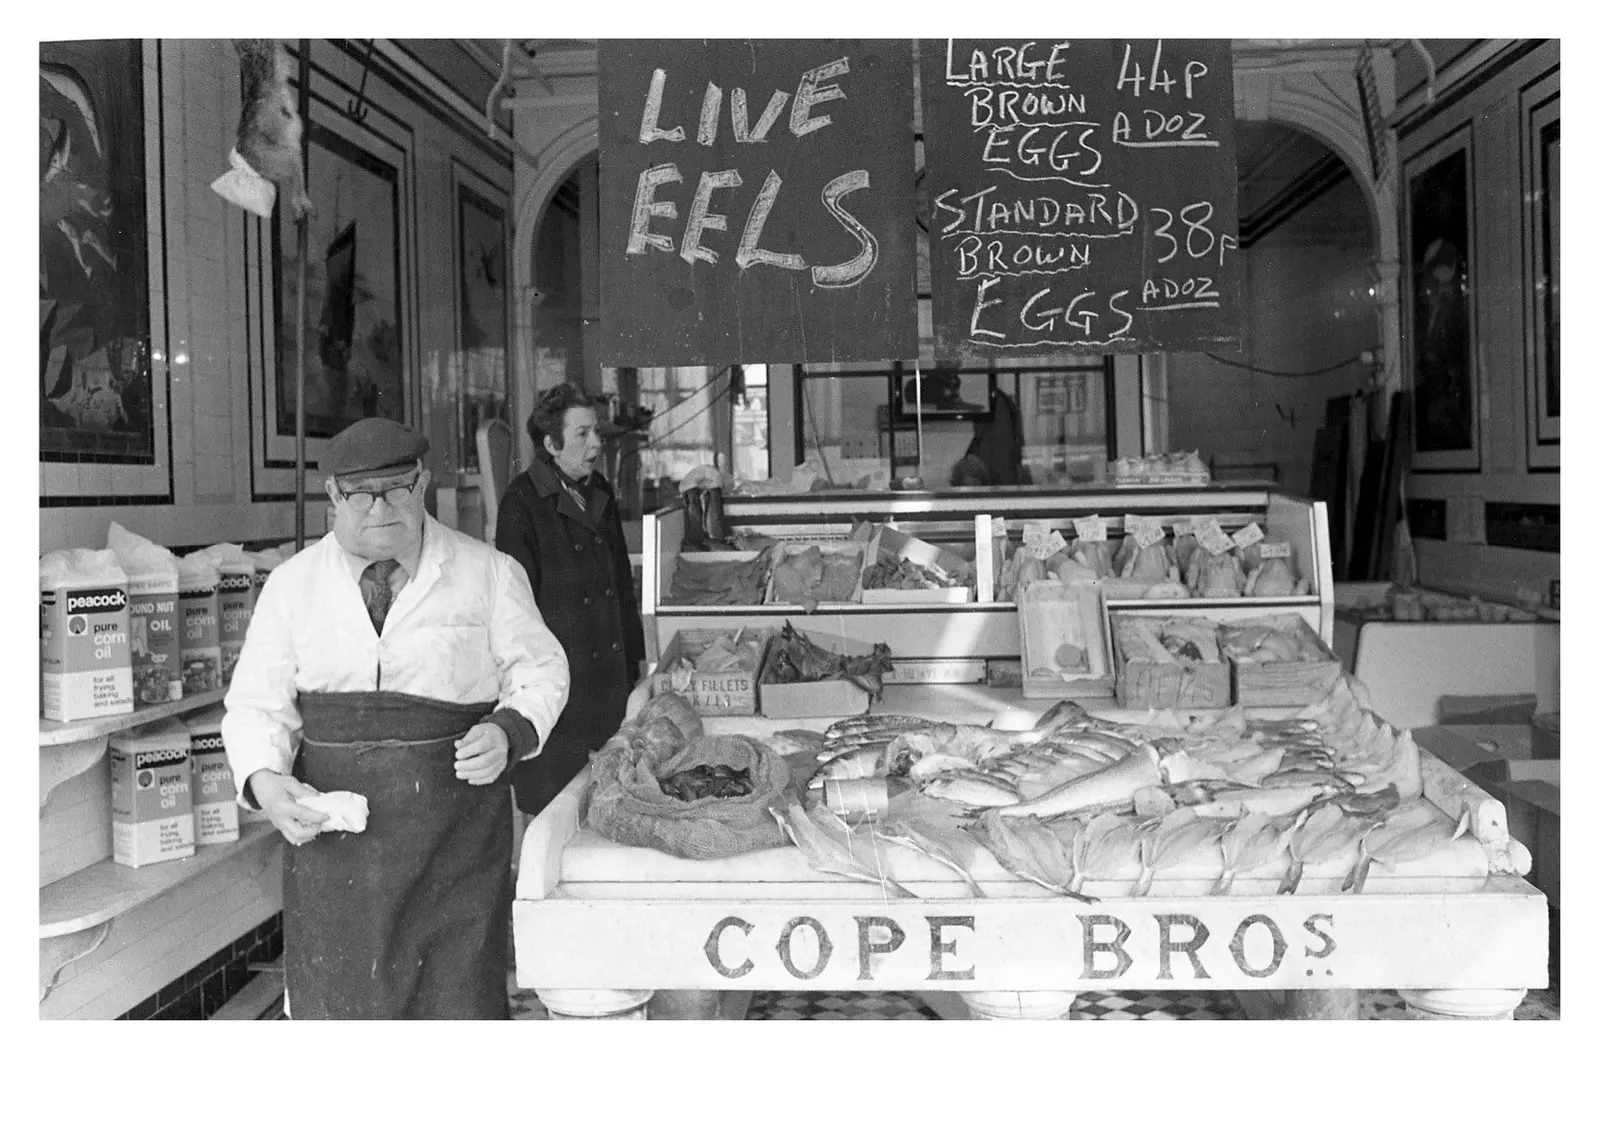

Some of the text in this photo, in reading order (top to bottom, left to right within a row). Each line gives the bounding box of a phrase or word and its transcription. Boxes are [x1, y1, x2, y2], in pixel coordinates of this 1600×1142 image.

[947, 38, 1070, 81] LARGE
[639, 56, 850, 146] LIVE
[964, 87, 1086, 125] BROWN
[983, 127, 1102, 176] EGGS
[934, 186, 1139, 233] STANDARD
[626, 162, 878, 288] EELS
[954, 236, 1090, 275] BROWN
[970, 277, 1133, 338] EGGS
[67, 591, 126, 613] peacock
[156, 601, 174, 613] NUT
[185, 607, 208, 617] pure
[223, 602, 245, 612] pure
[93, 622, 118, 635] pure
[94, 632, 126, 645] corn
[95, 644, 112, 660] oil
[702, 679, 748, 692] FILLETS
[201, 762, 224, 772] pure
[160, 775, 181, 786] pure
[702, 915, 975, 980] COPE
